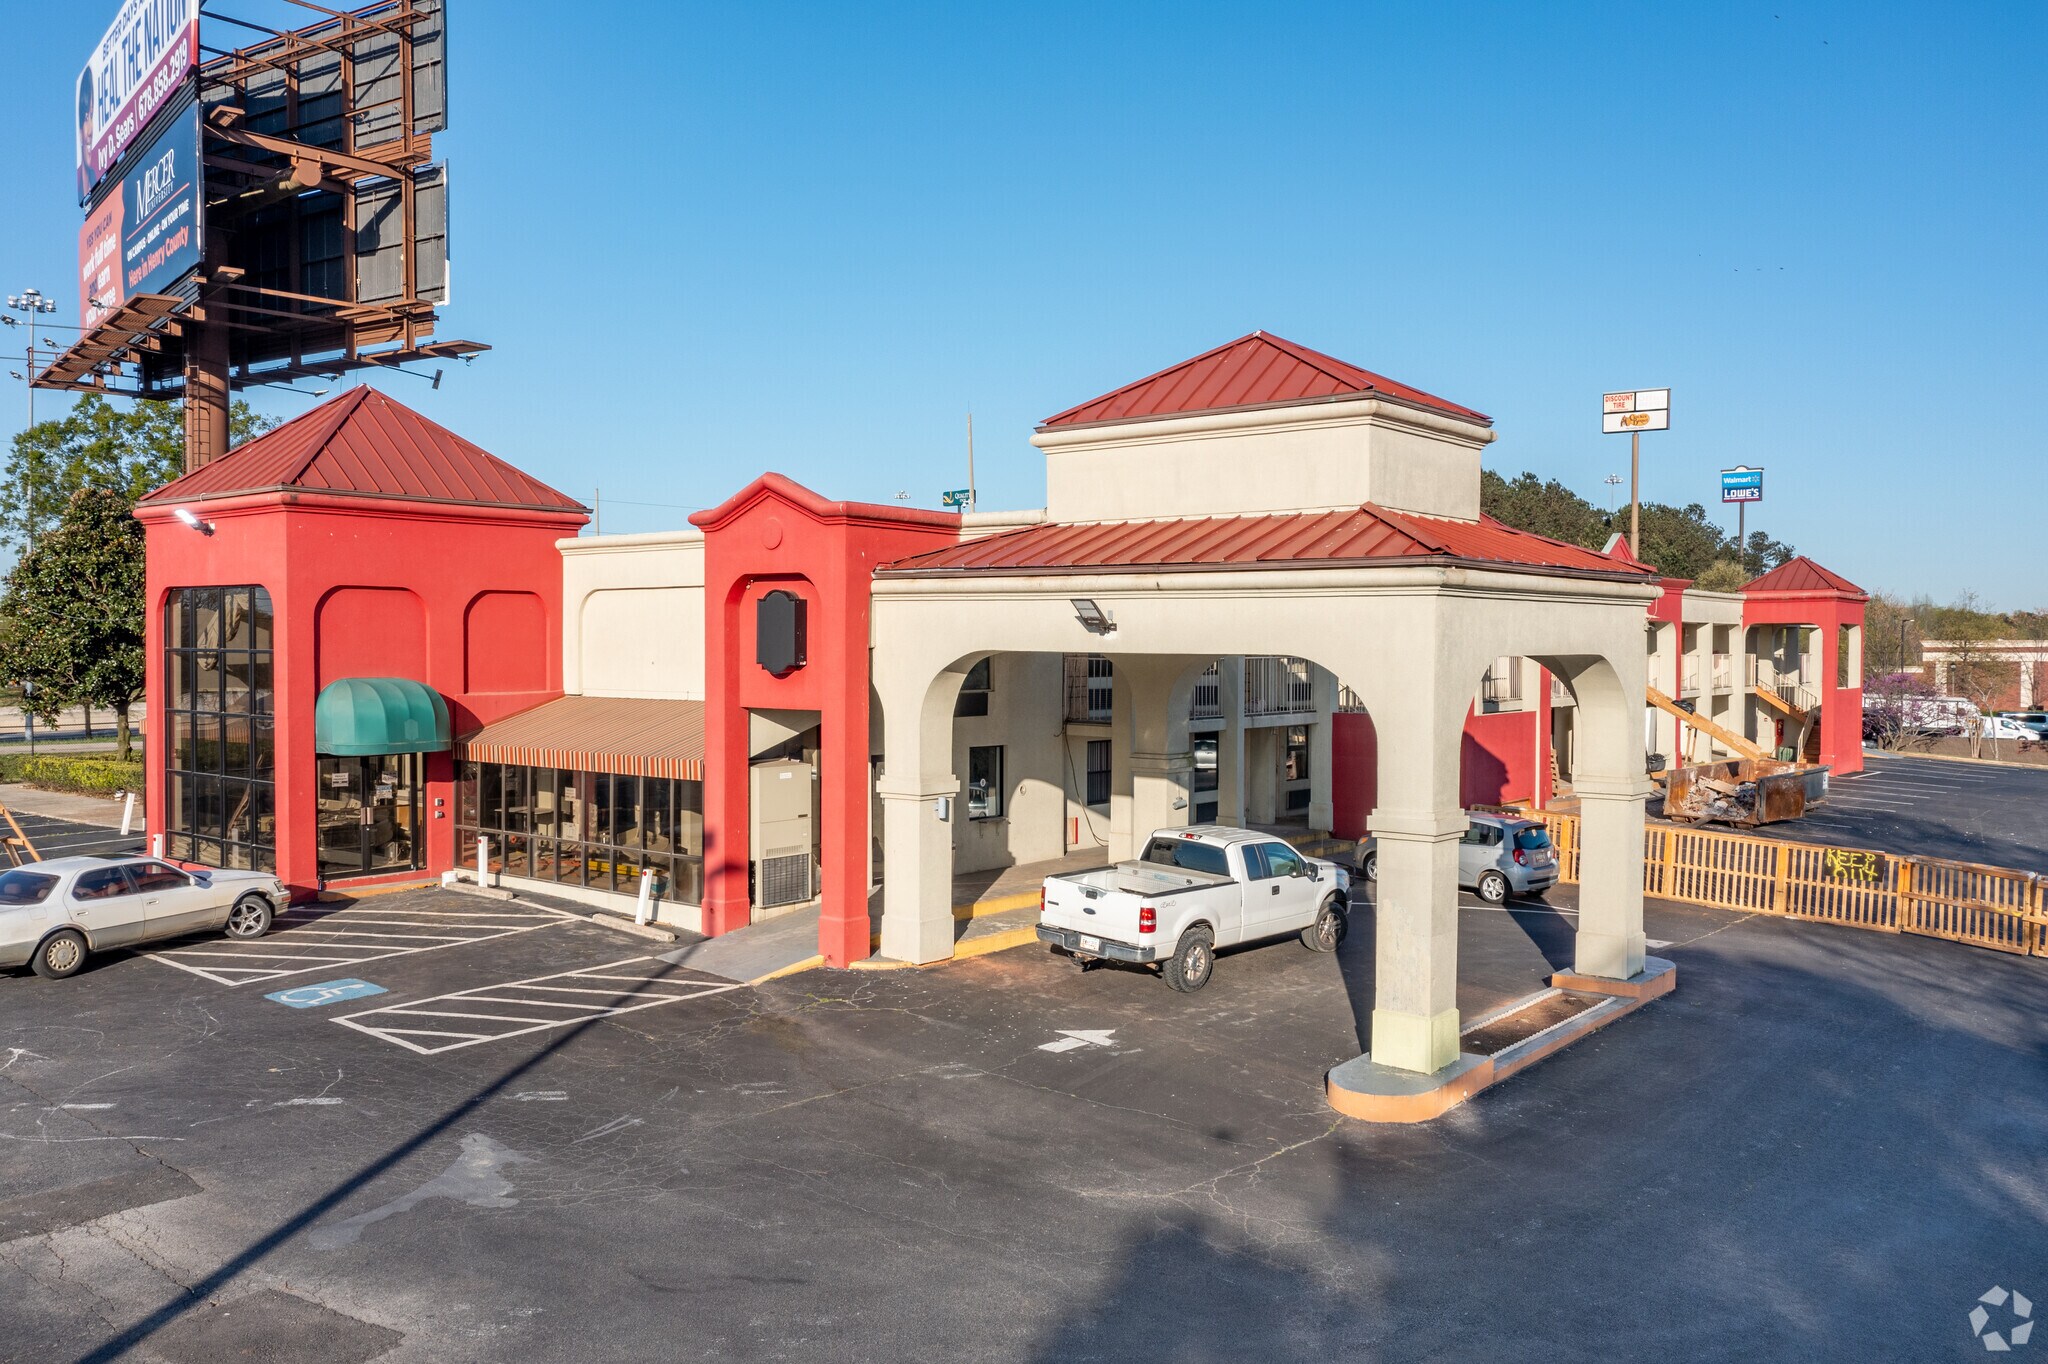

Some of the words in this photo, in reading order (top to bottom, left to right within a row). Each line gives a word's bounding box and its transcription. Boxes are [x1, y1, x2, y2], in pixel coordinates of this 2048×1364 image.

[97, 50, 121, 132] HEAL
[122, 16, 142, 97] THE
[98, 144, 108, 171] Ivy
[116, 112, 134, 149] Sears
[138, 37, 188, 121] 678.858.2919
[136, 148, 175, 225] MERCER
[148, 180, 174, 213] UNIVERSITY
[128, 266, 142, 288] Here
[148, 245, 165, 266] Henry
[165, 225, 189, 257] County
[1605, 394, 1633, 402] DISCOUNT
[1723, 476, 1751, 484] Walmart
[1724, 488, 1759, 498] LOWE'S
[1827, 848, 1876, 869] KEEP
